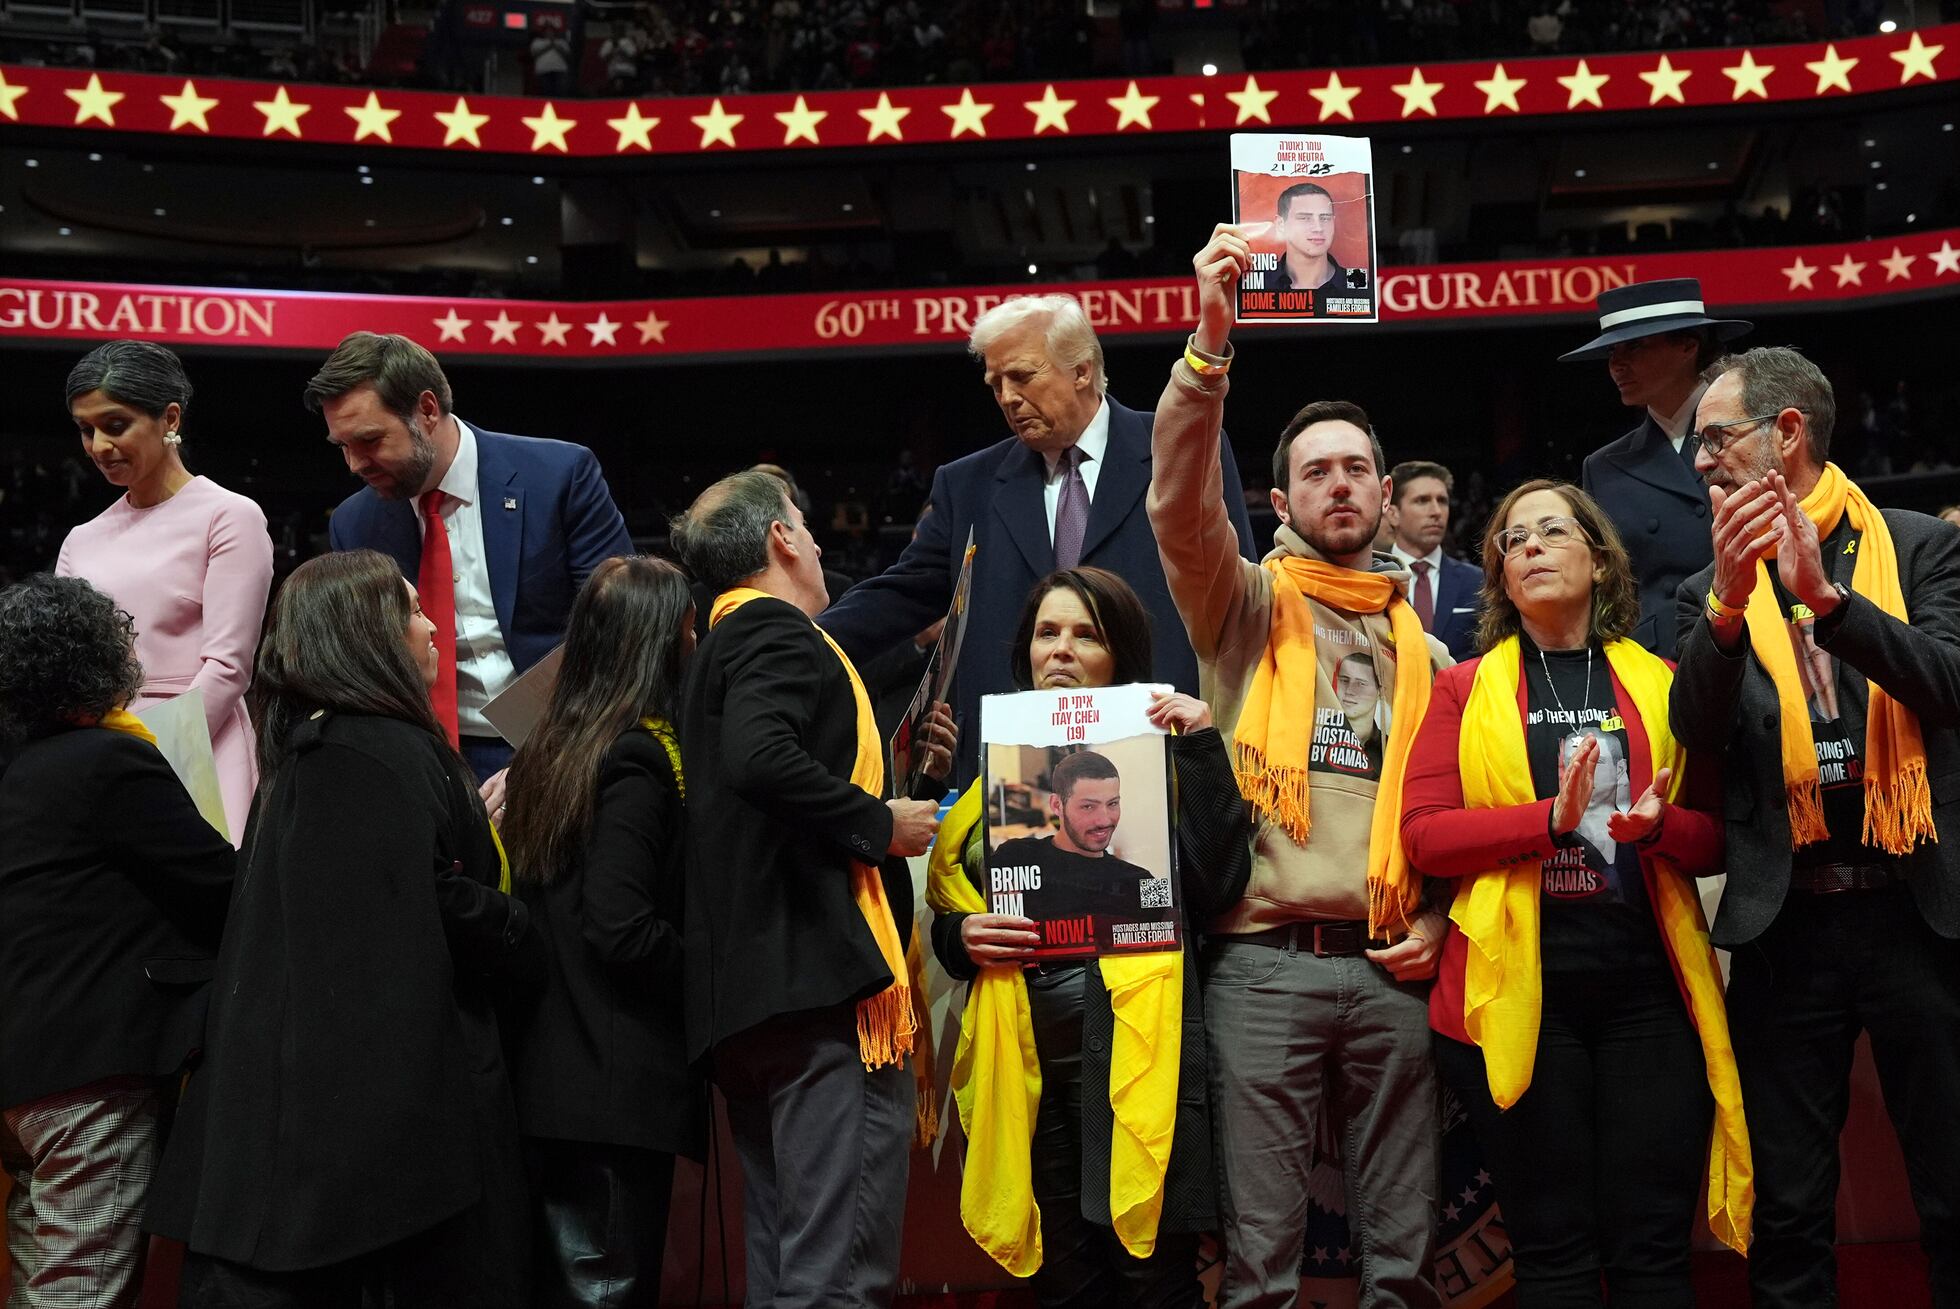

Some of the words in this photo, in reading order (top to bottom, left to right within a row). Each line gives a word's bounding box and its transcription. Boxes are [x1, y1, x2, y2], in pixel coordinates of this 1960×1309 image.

[1277, 152, 1297, 162] OMER
[1298, 152, 1325, 162] NEUTRA
[1248, 253, 1278, 271] RING
[1241, 272, 1265, 290] HIM
[1377, 265, 1636, 313] GURATION
[1242, 292, 1276, 310] HOME
[1279, 290, 1314, 310] NOW!
[1327, 303, 1351, 312] FAMILIES
[1351, 304, 1370, 312] FORUM
[814, 299, 900, 338] 60TH
[1327, 629, 1353, 645] THEM
[1058, 696, 1069, 711] חן
[1071, 695, 1093, 709] איתי
[1052, 711, 1072, 726] ITAY
[1075, 709, 1099, 724] CHEN
[1316, 707, 1345, 727] HELD
[1545, 708, 1576, 724] THEM
[1577, 707, 1609, 724] HOME
[1067, 725, 1085, 741] (19)
[1311, 745, 1328, 763] BY
[1329, 747, 1369, 770] HAMAS
[1815, 741, 1844, 761] RING
[1820, 762, 1847, 784] OME
[990, 865, 1041, 893] BRING
[1545, 870, 1597, 892] HAMAS
[992, 892, 1025, 917] HIM
[1045, 914, 1095, 944] NOW!
[1112, 923, 1139, 933] HOSTAGES
[1139, 922, 1150, 931] AND
[1151, 921, 1174, 930] MISSING
[1113, 931, 1147, 944] FAMILIES
[1148, 930, 1175, 942] FORUM
